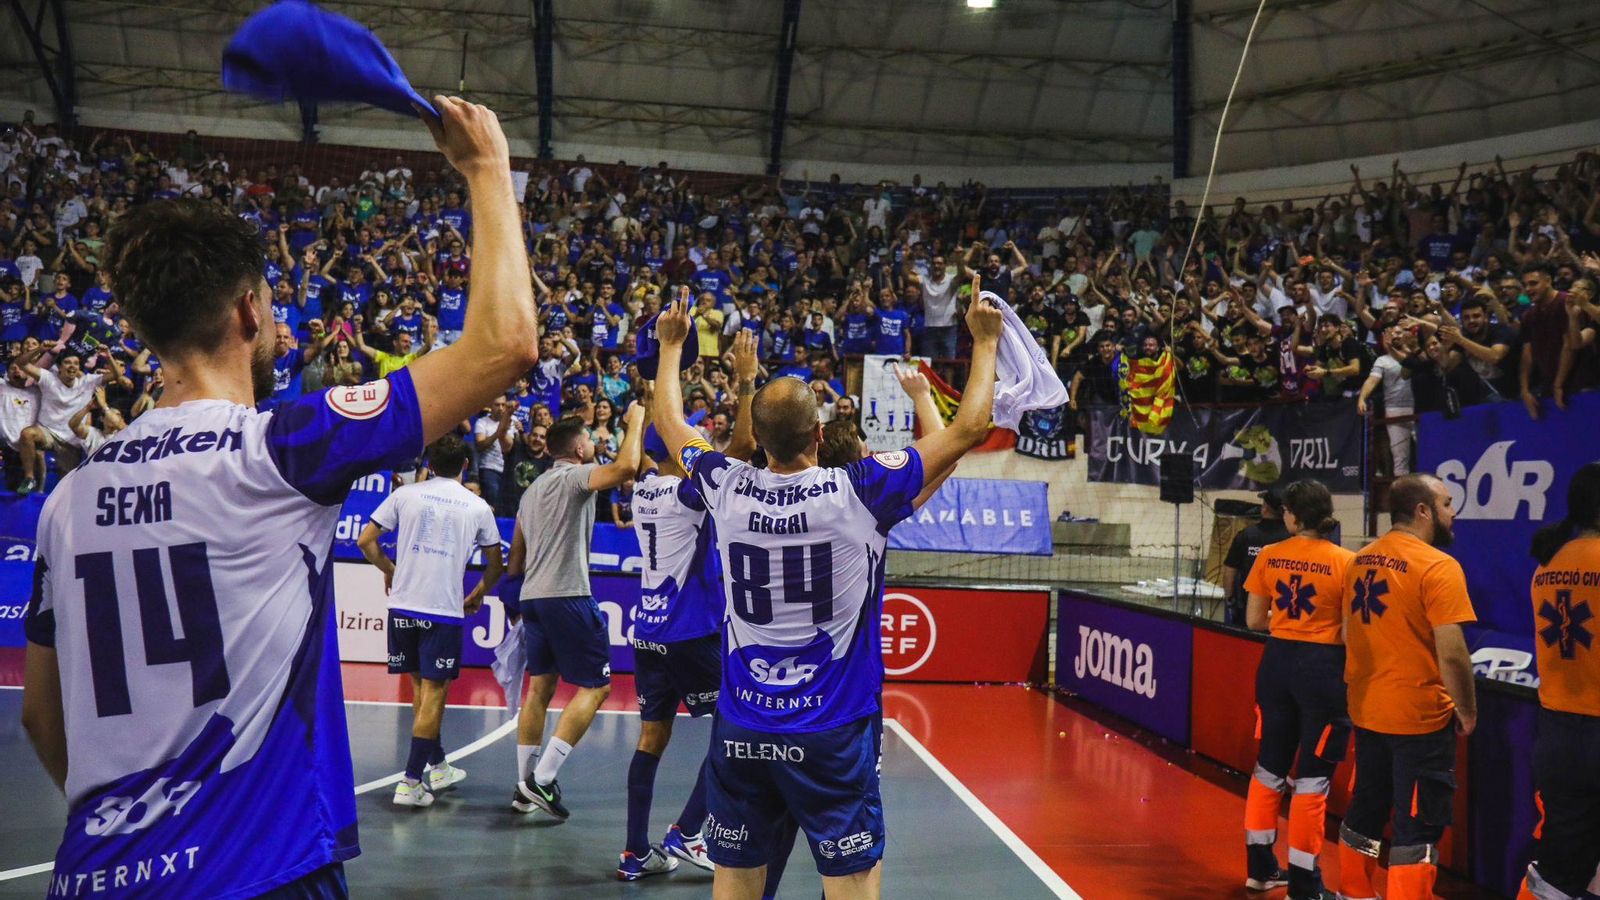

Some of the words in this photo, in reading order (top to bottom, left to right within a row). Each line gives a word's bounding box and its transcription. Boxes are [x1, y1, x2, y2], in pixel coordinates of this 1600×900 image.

[96, 481, 172, 527] SEXA
[335, 514, 368, 540] di
[748, 512, 808, 534] GABRI
[642, 523, 657, 570] 7
[1310, 562, 1332, 576] CIVIL
[1386, 558, 1408, 573] CIVIL
[728, 541, 834, 625] 84
[1582, 571, 1600, 587] CIV
[75, 541, 231, 718] 14
[337, 611, 384, 631] lzira
[880, 615, 918, 631] RF
[880, 638, 917, 654] EF
[1075, 625, 1156, 699] Joma
[736, 687, 823, 709] INTERNXT
[723, 740, 804, 762] TELENO
[714, 824, 748, 841] fresh
[837, 831, 873, 849] GFS
[717, 840, 742, 850] PEOPLE
[841, 843, 874, 857] SECURITY
[50, 846, 200, 897] INTERNXT
